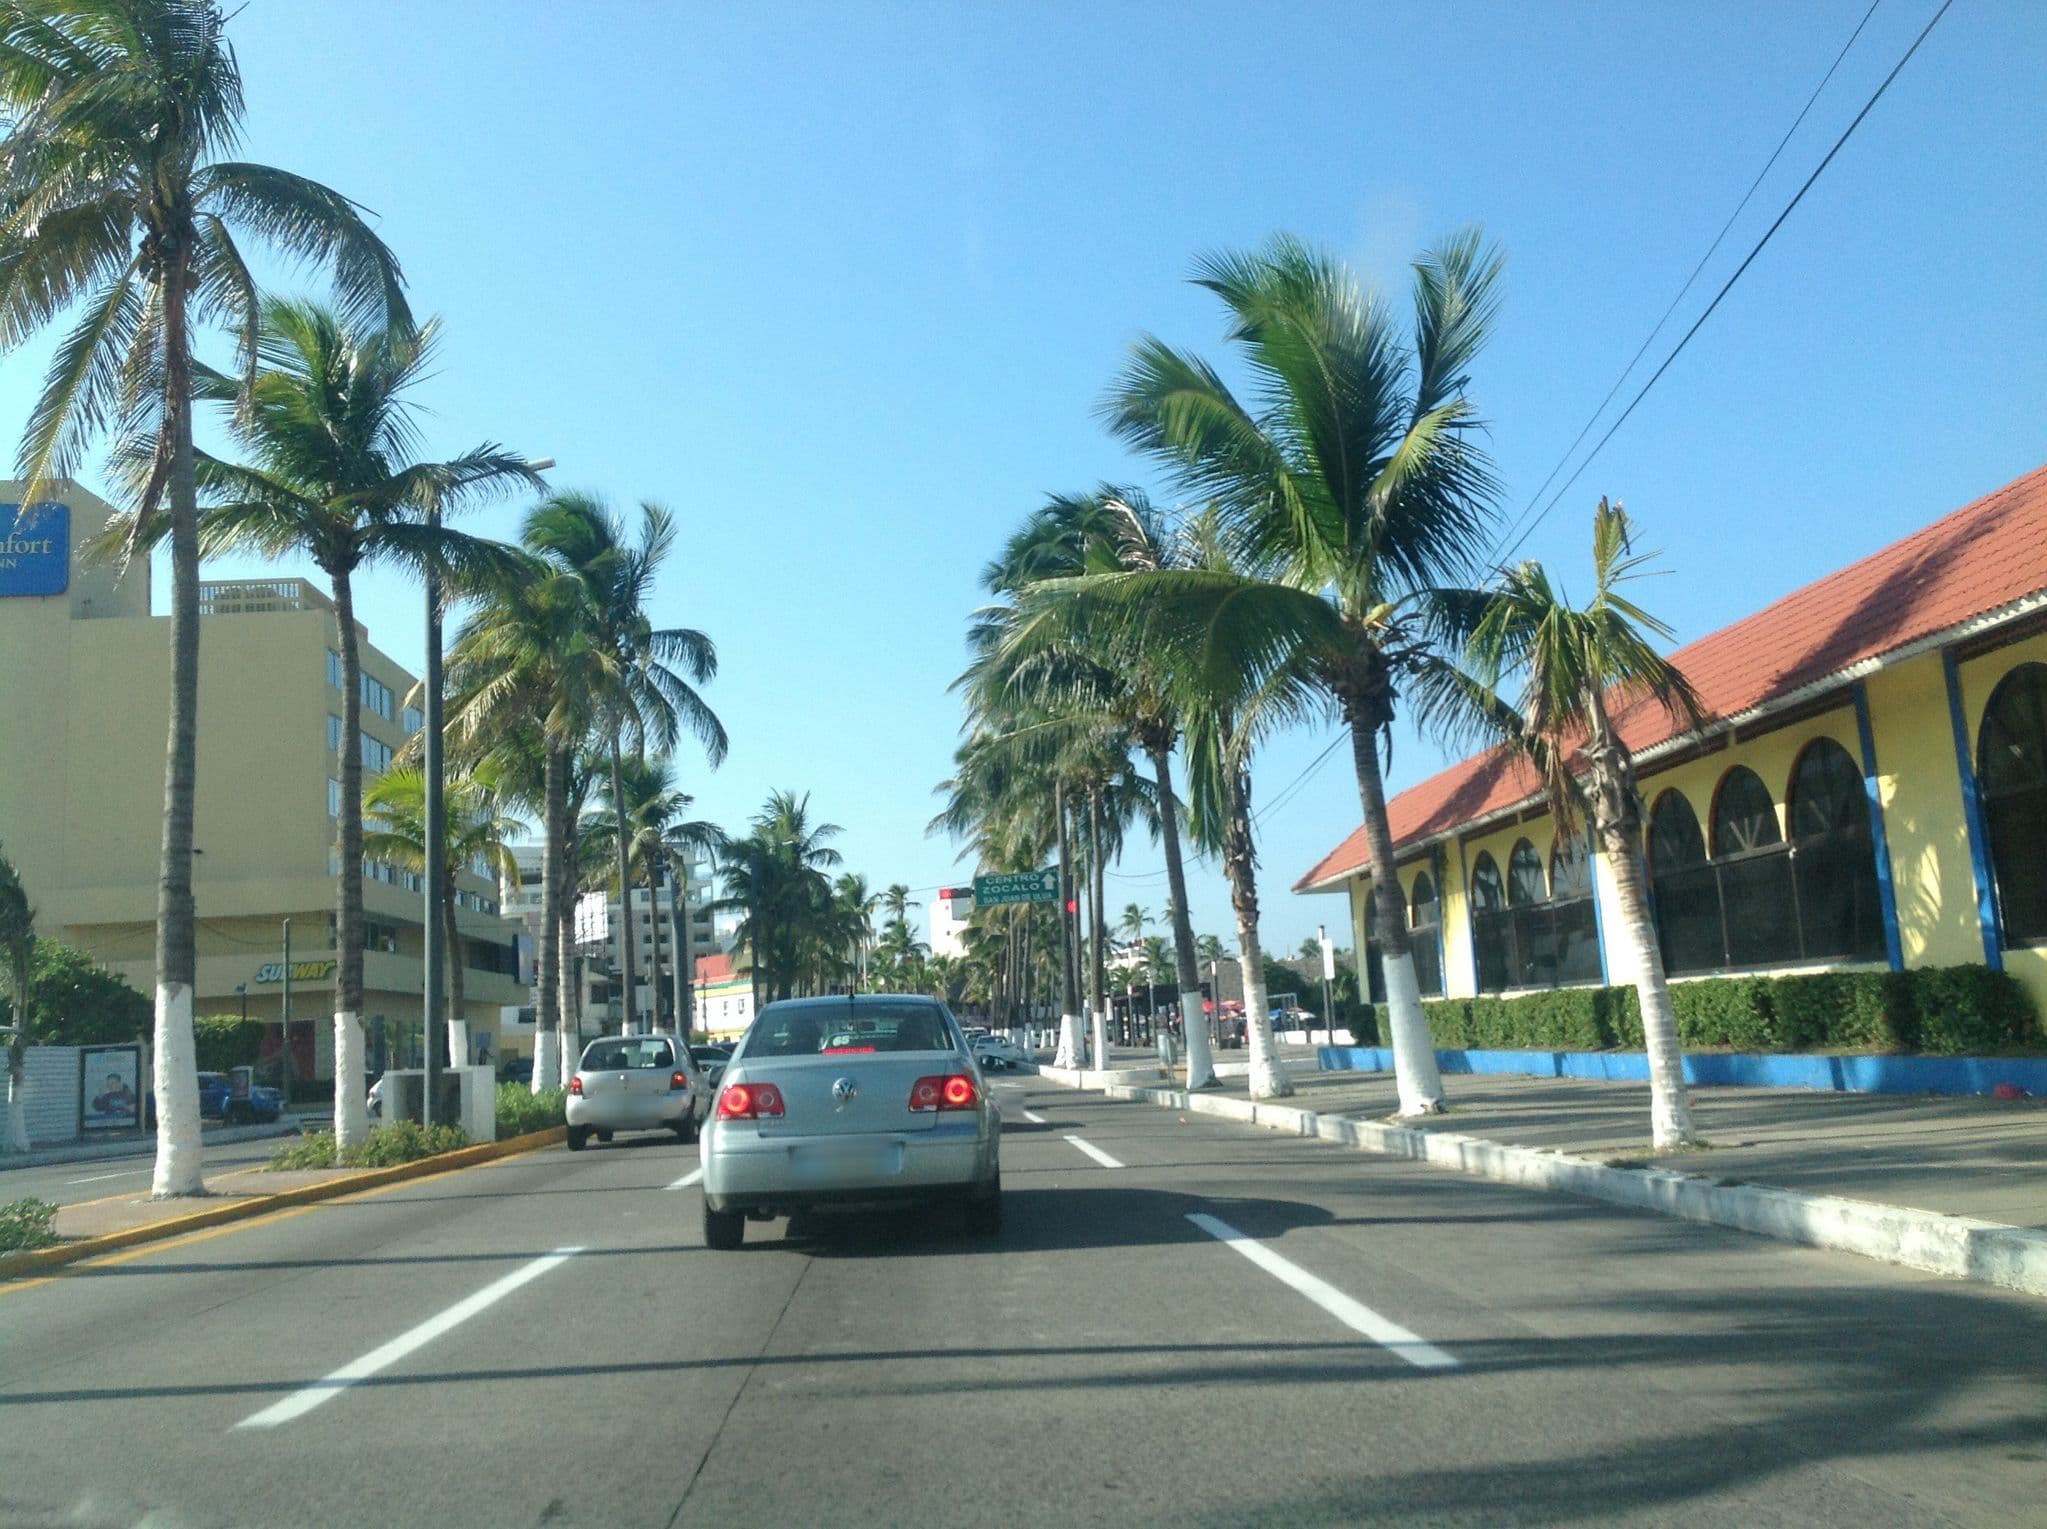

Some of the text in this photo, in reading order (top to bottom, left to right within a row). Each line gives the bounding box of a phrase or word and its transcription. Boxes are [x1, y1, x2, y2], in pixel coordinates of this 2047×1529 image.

[0, 531, 53, 554] fort
[985, 873, 1040, 885] CENTRO
[982, 882, 1040, 895] ZOCALO
